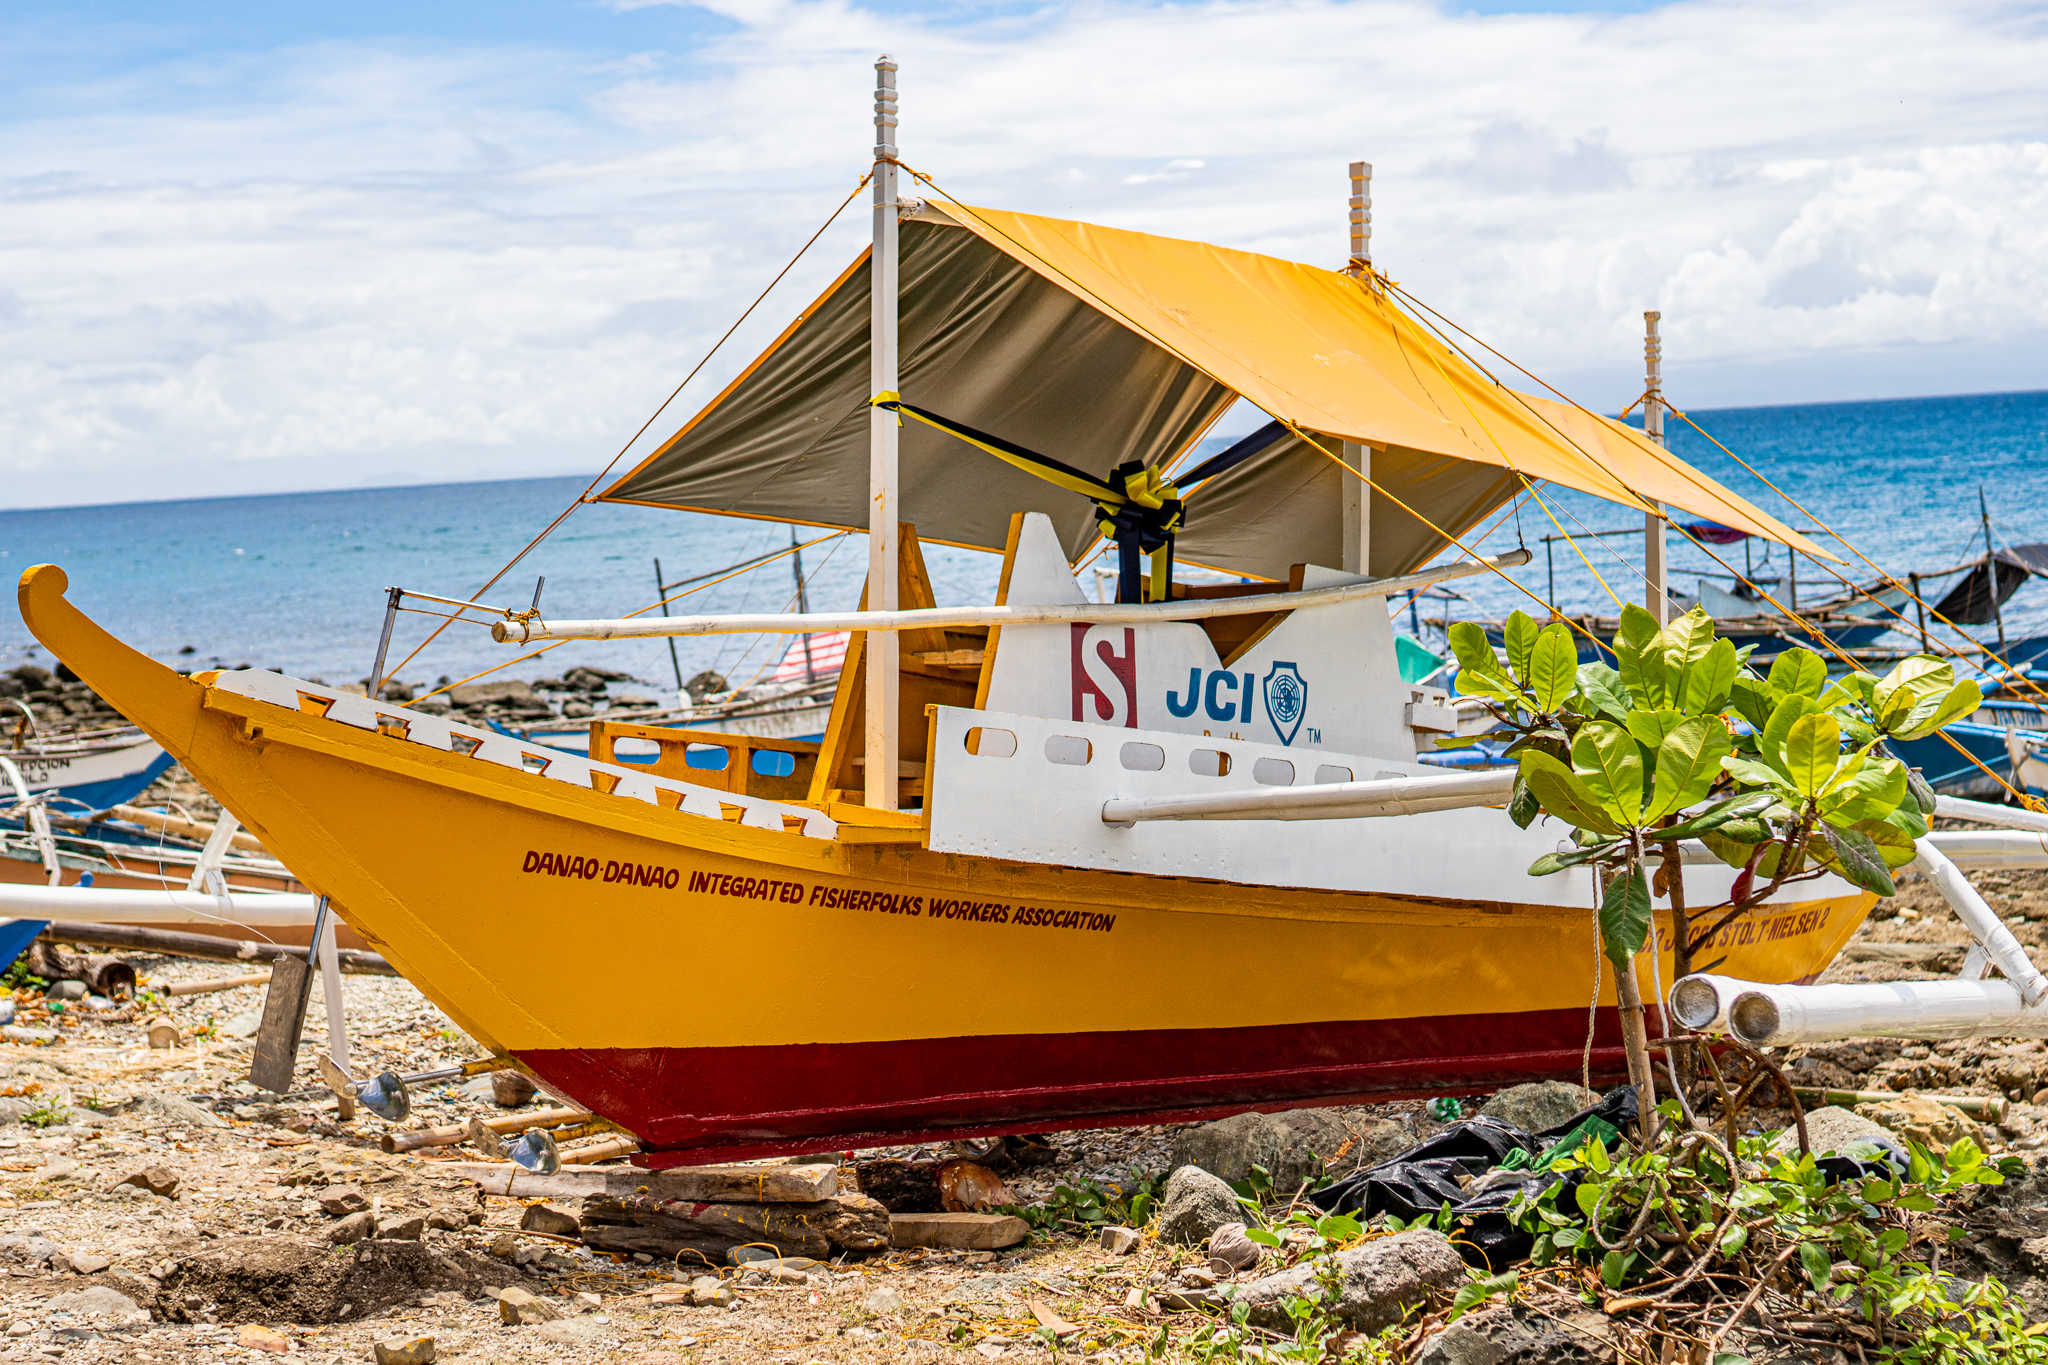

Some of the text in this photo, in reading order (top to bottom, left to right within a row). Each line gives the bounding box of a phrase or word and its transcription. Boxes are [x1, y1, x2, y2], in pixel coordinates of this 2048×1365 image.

[1166, 667, 1255, 723] JCI
[1307, 728, 1322, 744] TM
[688, 870, 805, 905] INTEGRATED
[808, 885, 923, 917] FISHERFOLKS
[928, 897, 1011, 924] WORKERS
[1011, 906, 1117, 933] ASSOCIATION
[1818, 906, 1831, 929] 2
